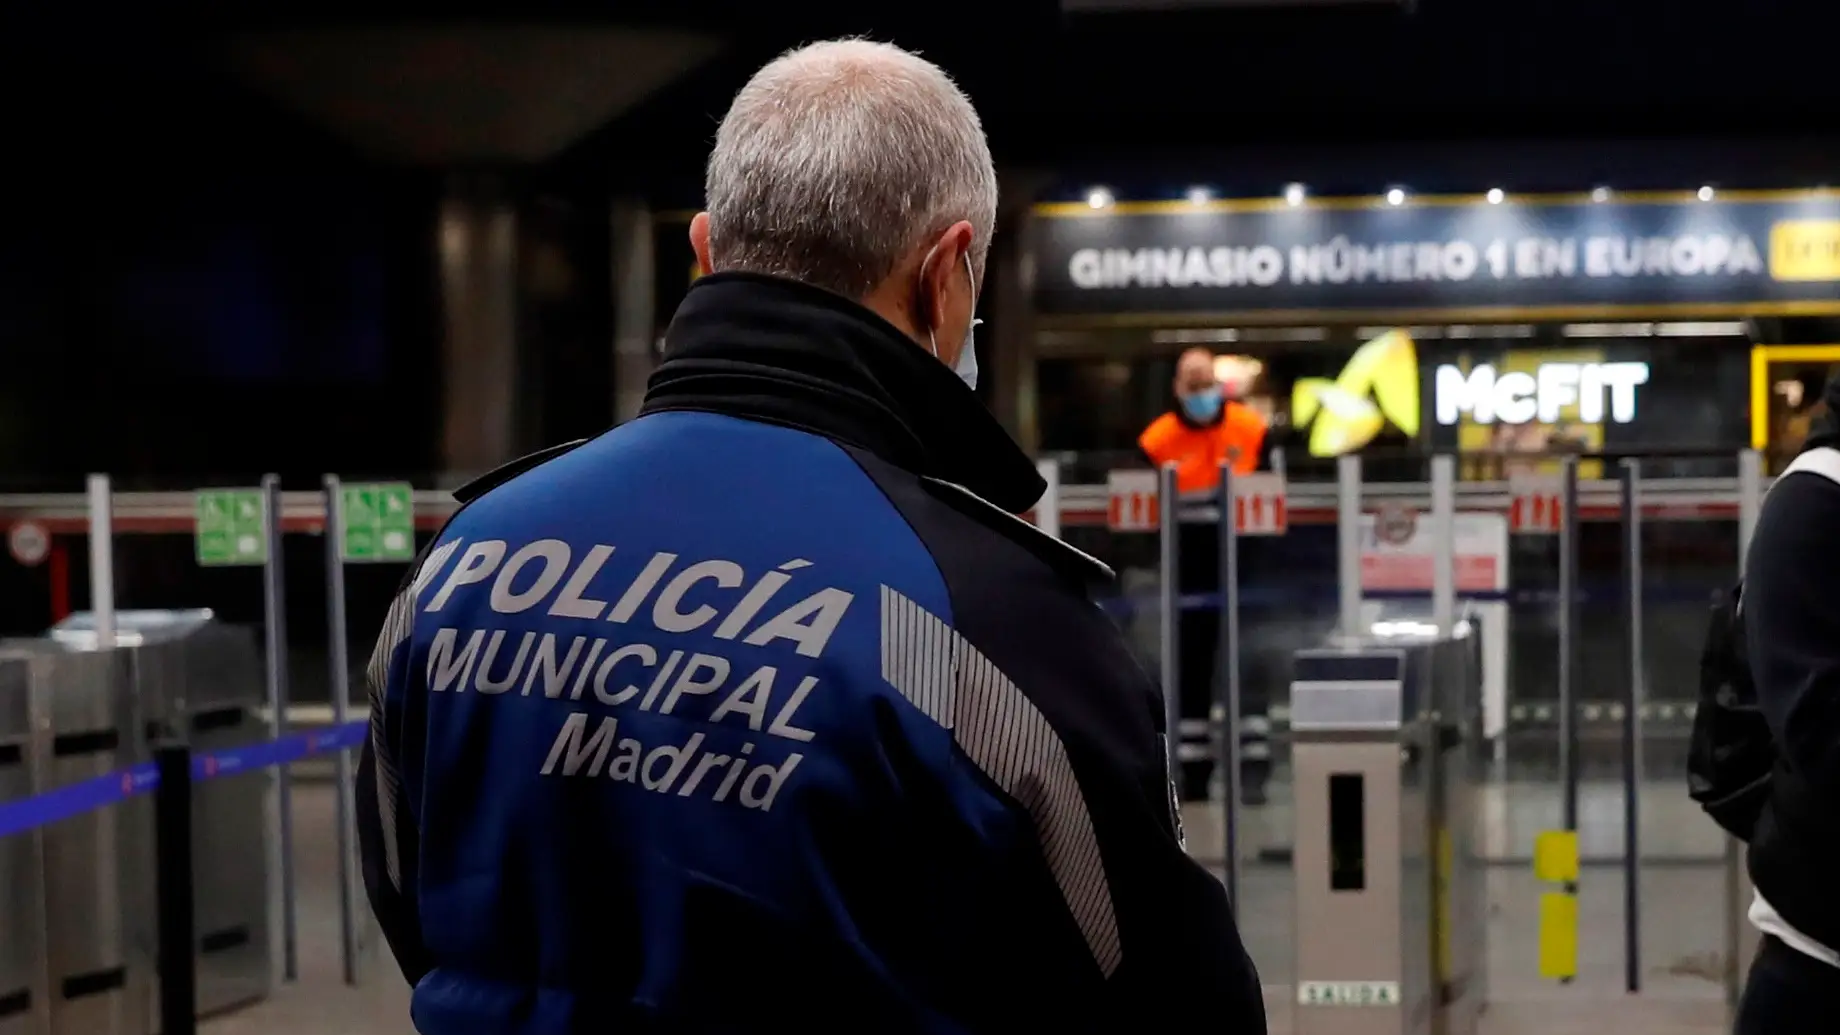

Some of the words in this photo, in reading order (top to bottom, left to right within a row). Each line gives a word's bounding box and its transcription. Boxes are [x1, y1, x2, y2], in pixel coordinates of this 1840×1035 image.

[1069, 245, 1284, 288] GIMNASIO
[1290, 234, 1477, 284] NÚMERO
[1485, 236, 1508, 279] 1
[1515, 236, 1576, 279] EN
[1584, 234, 1763, 278] EUROPA
[1435, 361, 1649, 425] McFIT
[424, 538, 855, 659] POLICÍA
[427, 628, 819, 743] MUNICIPAL
[540, 713, 804, 813] Madrid
[1307, 984, 1391, 1004] SALIDA
